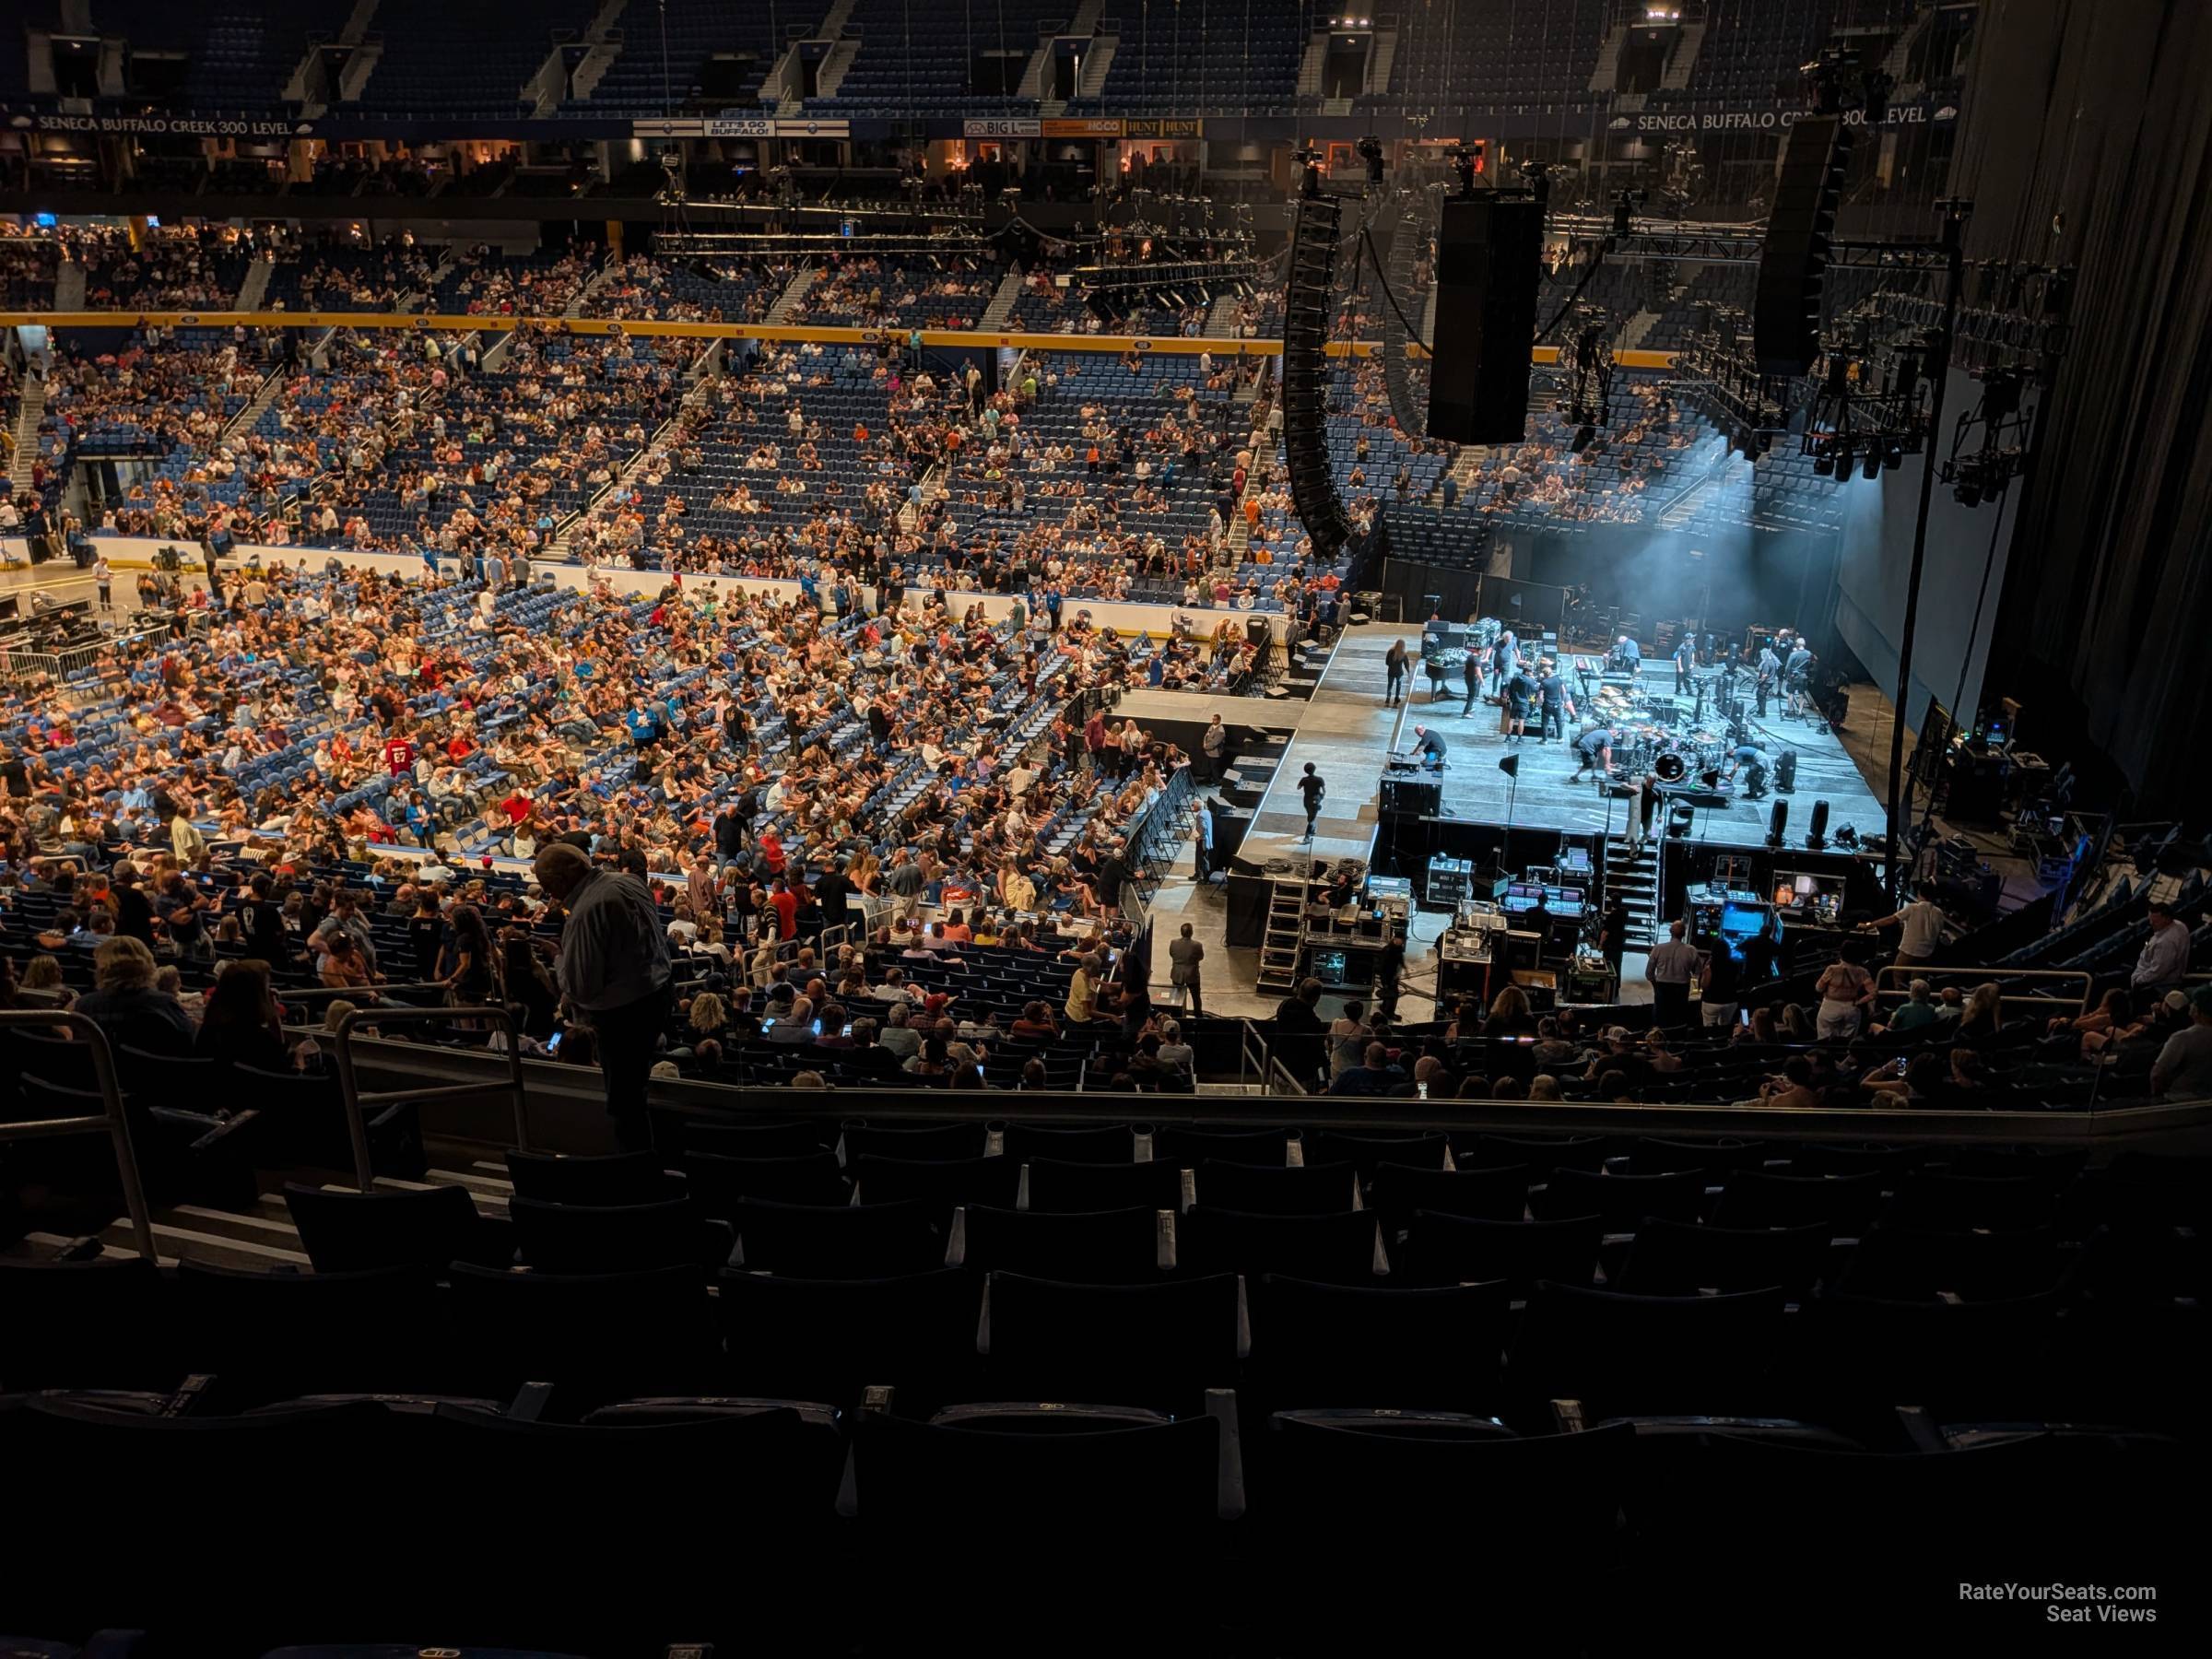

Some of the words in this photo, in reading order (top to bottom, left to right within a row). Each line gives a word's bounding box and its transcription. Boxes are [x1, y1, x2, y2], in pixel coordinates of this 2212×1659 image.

[39, 116, 97, 131] SENECA
[102, 118, 167, 133] BUFFALO
[171, 120, 218, 134] CREEK
[218, 122, 248, 134] 300
[253, 123, 292, 135] LEVEL
[1128, 121, 1158, 133] HUNT
[1165, 121, 1196, 133] HUNT
[1637, 115, 1697, 130] SENECA
[1702, 112, 1775, 129] BUFFALO
[987, 122, 1007, 134] BIG
